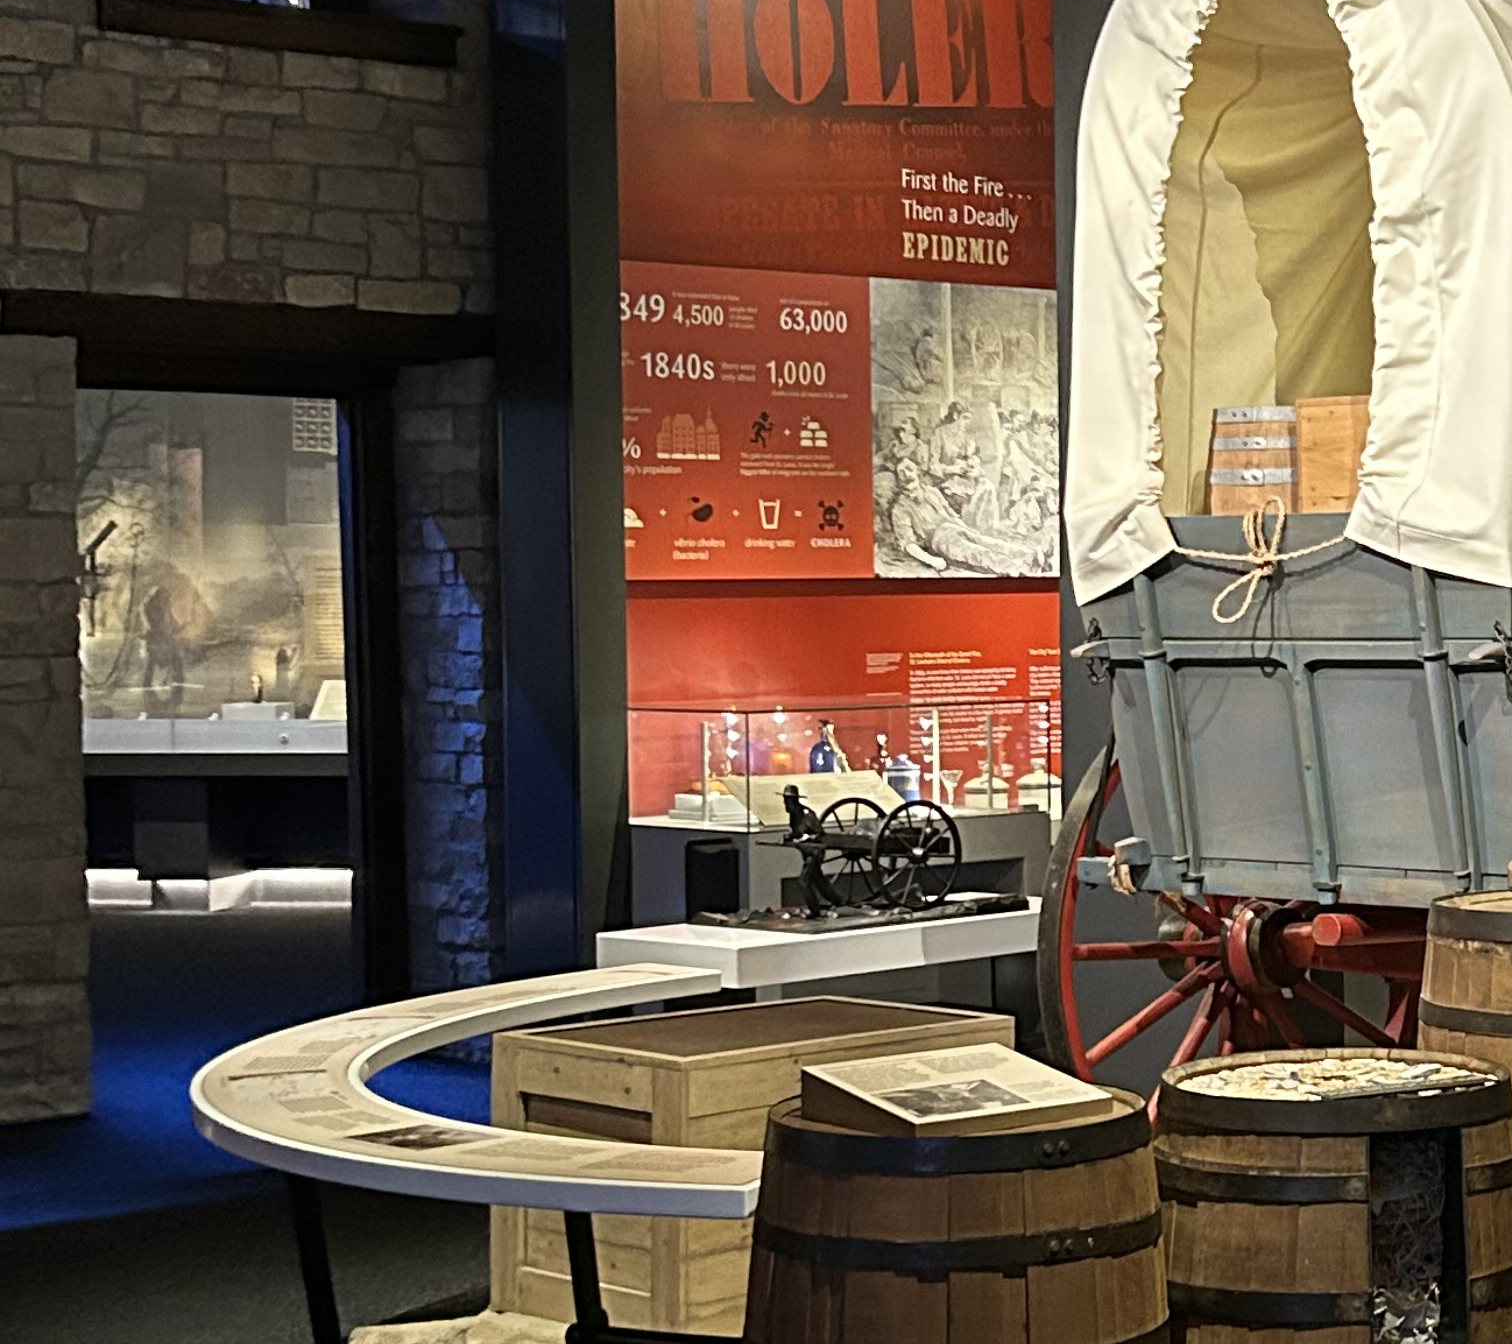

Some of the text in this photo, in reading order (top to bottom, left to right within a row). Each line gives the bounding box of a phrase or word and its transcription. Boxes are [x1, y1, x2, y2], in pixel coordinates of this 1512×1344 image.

[901, 168, 936, 191] First
[942, 171, 968, 194] the
[901, 199, 943, 223] Then
[949, 209, 958, 223] a
[963, 205, 1019, 234] Deadly
[901, 232, 1010, 266] EPIDEMIC
[672, 304, 724, 327] 4,500
[779, 307, 848, 334] 63,000
[640, 352, 715, 380] 1840s
[765, 359, 827, 388] 1,000
